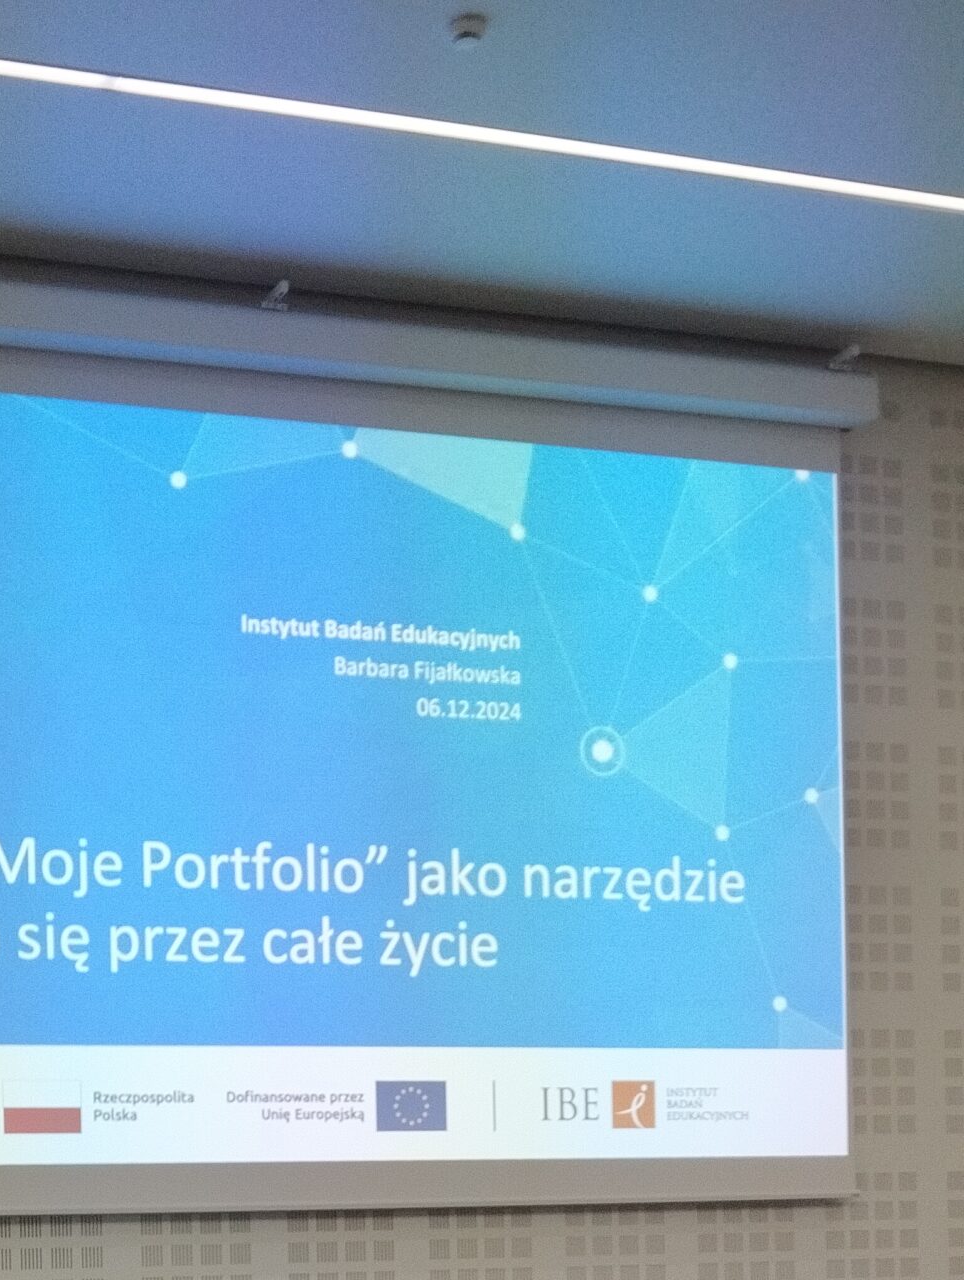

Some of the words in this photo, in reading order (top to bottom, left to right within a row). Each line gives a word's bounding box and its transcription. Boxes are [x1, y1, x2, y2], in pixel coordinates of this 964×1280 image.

[241, 614, 319, 639] Instytut
[324, 620, 386, 642] Badań
[391, 623, 521, 652] Edukacyjnych
[334, 655, 409, 679] Barbara
[414, 660, 521, 685] Fijałkowska
[416, 697, 522, 721] 06.12.2024
[402, 847, 508, 907] jako
[523, 855, 747, 912] narzędzie
[17, 911, 91, 973] się
[109, 922, 246, 974] przez
[261, 916, 364, 967] całe
[378, 919, 499, 978] życie
[93, 1090, 195, 1105] Rzeczpospolita
[226, 1090, 325, 1103] Dofinansowane
[330, 1093, 365, 1104] przez
[666, 1087, 718, 1097] INSTYTUT
[541, 1087, 600, 1122] IBE
[93, 1108, 137, 1121] Polska
[261, 1108, 290, 1122] Unię
[295, 1107, 365, 1122] Europejską
[666, 1111, 749, 1122] EDUKACYJNYCH
